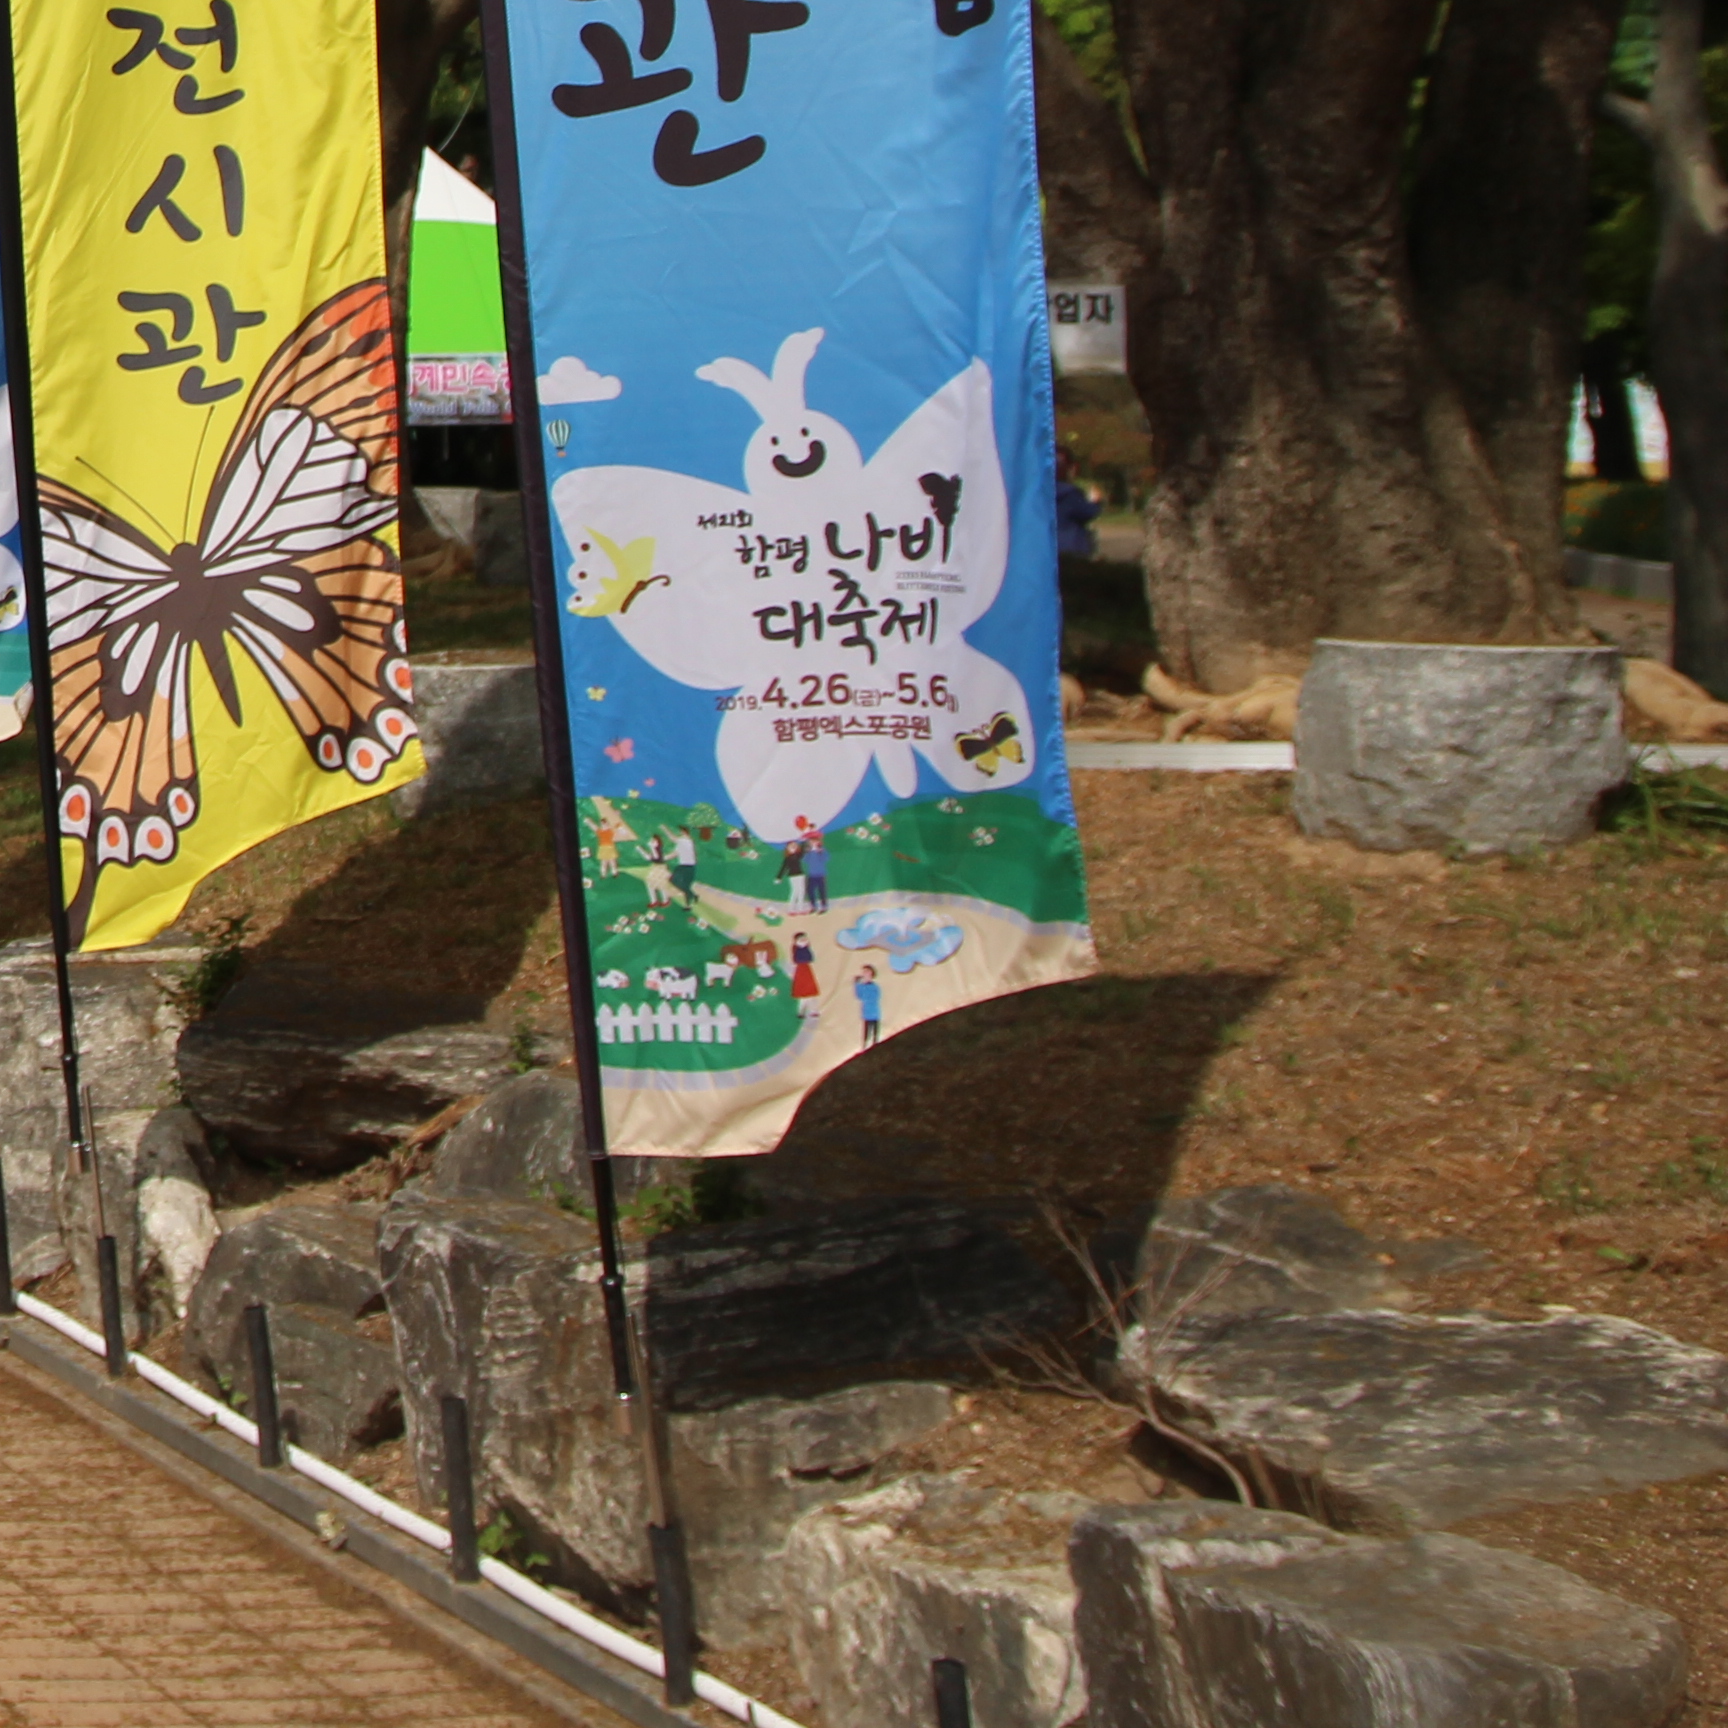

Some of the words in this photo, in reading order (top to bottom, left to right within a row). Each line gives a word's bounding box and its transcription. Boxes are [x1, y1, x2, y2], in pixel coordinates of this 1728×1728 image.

[734, 533, 810, 579] 함평
[824, 508, 956, 572] 나비
[752, 568, 939, 666] 대축제
[772, 714, 933, 743] 함평엑스포공원
